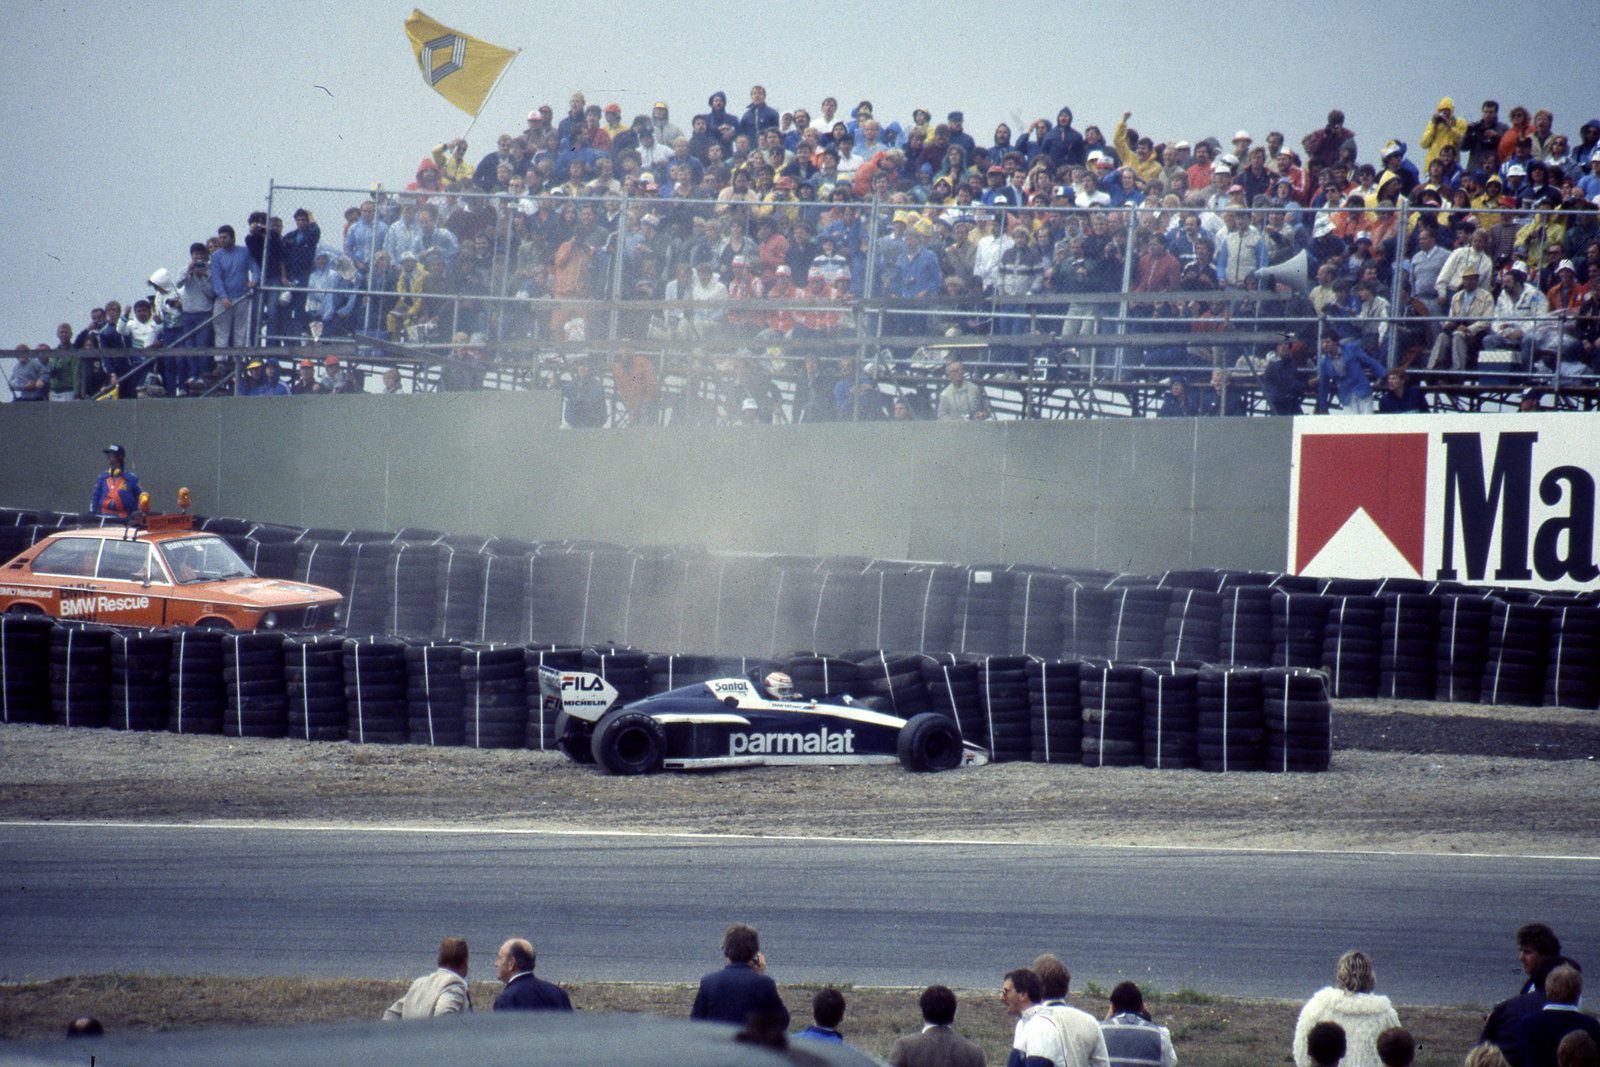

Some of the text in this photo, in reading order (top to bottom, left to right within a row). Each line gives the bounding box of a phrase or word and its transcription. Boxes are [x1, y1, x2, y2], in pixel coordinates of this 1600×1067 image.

[17, 588, 53, 598] Nederland
[60, 596, 150, 616] BMW Rescue
[561, 676, 604, 691] FILA
[729, 727, 855, 757] parmalat
